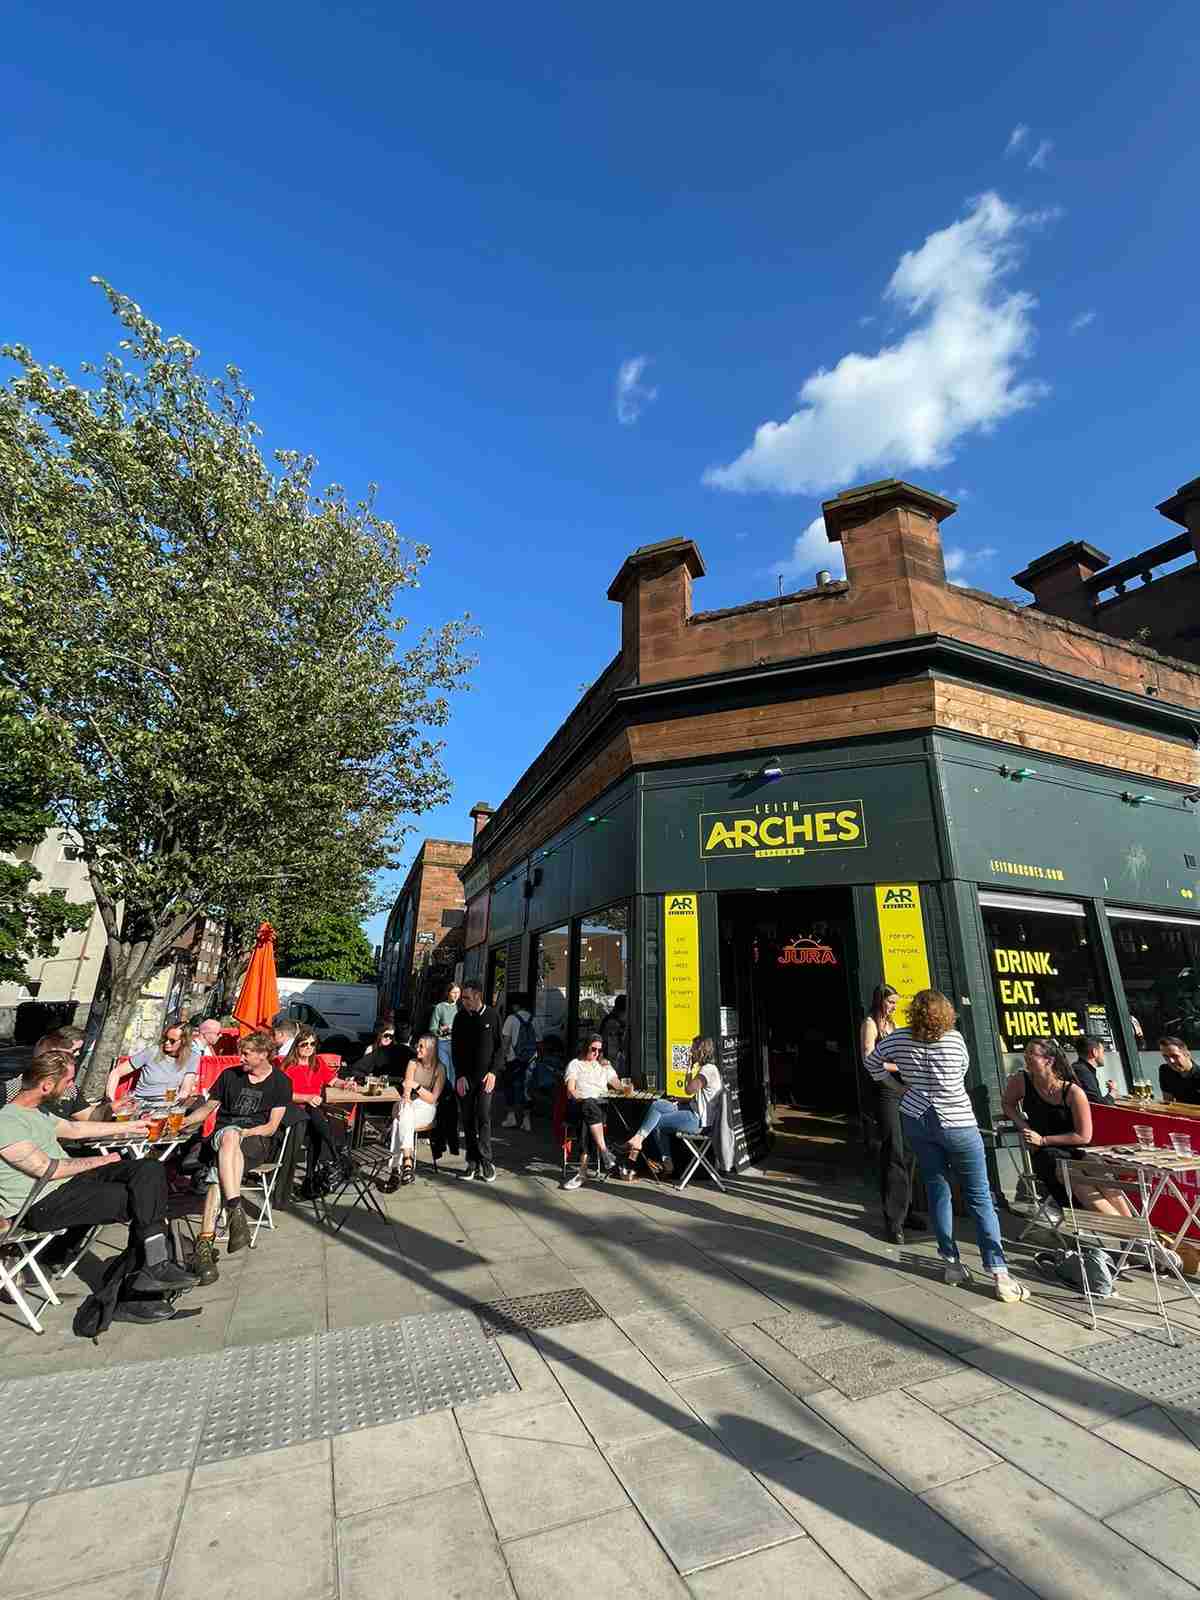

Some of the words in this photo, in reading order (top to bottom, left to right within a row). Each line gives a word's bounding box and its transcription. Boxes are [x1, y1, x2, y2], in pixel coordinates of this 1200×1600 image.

[755, 801, 800, 815] LEITH
[704, 810, 861, 850] ARCHES
[777, 950, 837, 964] JURA
[994, 948, 1059, 976] DRINK.
[999, 980, 1041, 1005] EAT.
[1004, 1011, 1052, 1036] HIRE
[1052, 1011, 1085, 1036] ME.
